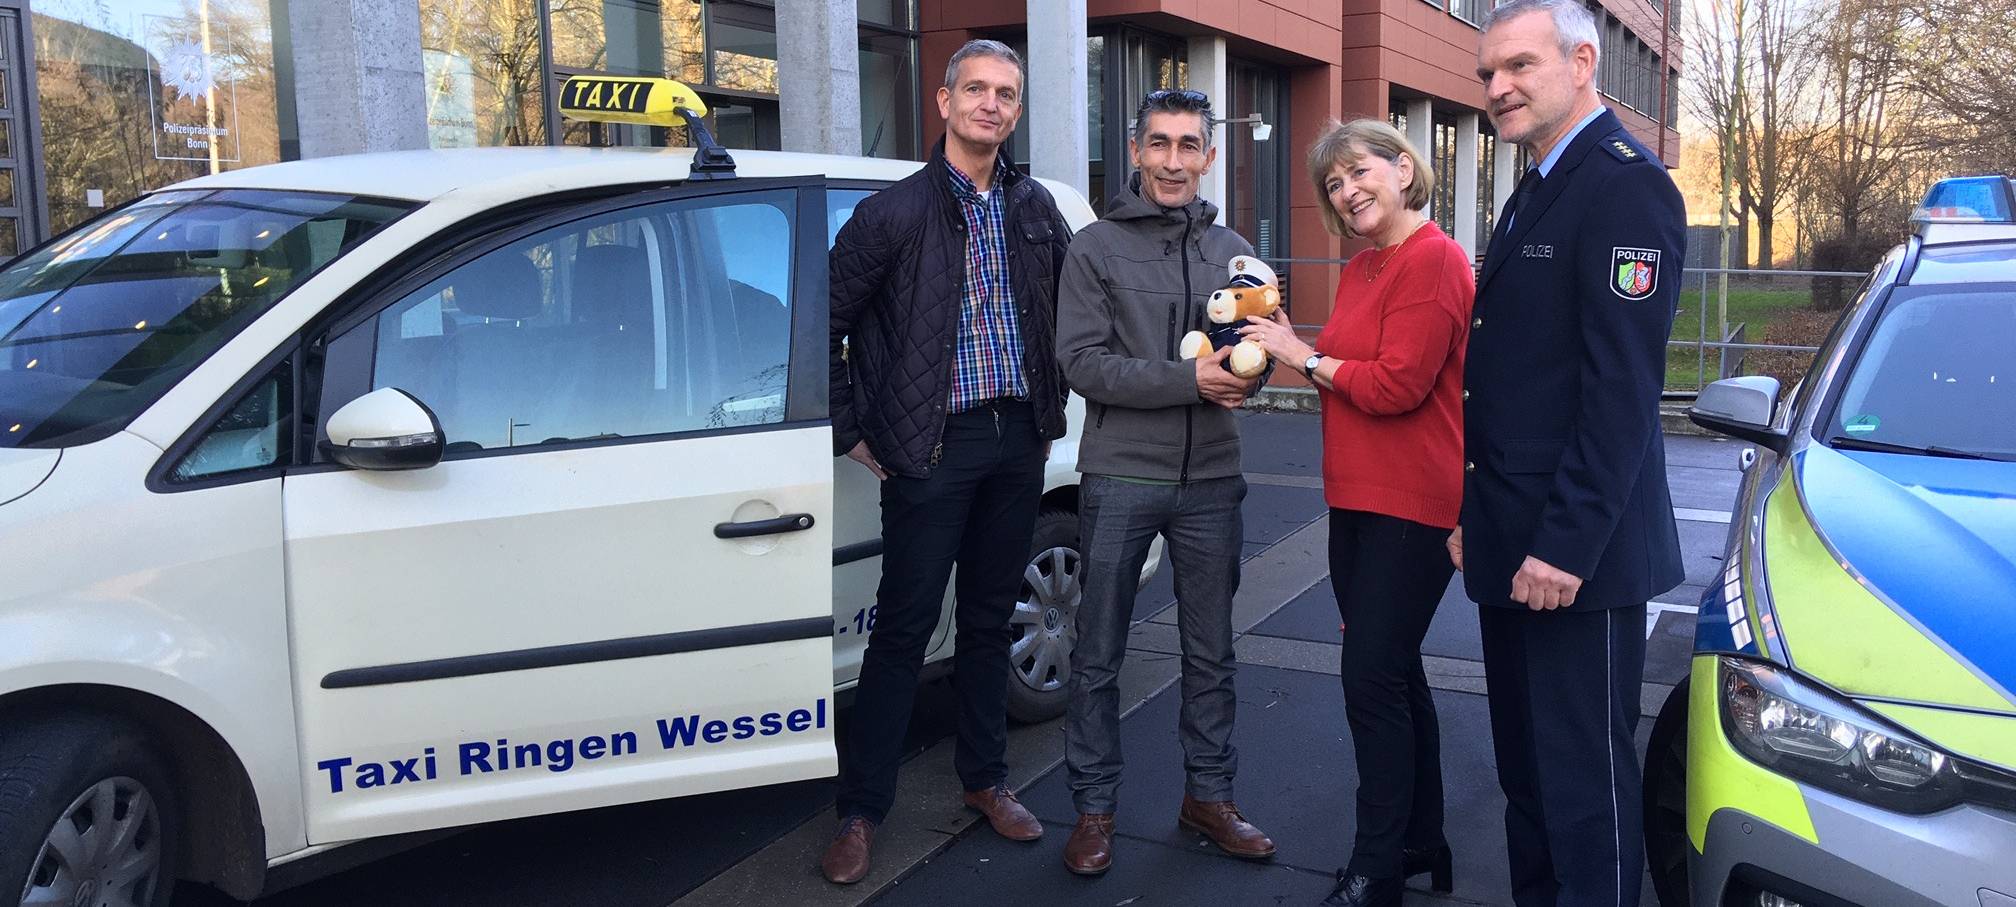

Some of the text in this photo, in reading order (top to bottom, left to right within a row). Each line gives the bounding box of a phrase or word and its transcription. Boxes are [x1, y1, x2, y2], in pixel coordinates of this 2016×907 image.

[573, 81, 640, 110] TAXI
[187, 137, 208, 149] Bonn
[1521, 244, 1554, 259] POLIZEI
[1617, 250, 1657, 262] POLIZEI
[317, 698, 826, 793] Taxi Ringen Wessel
